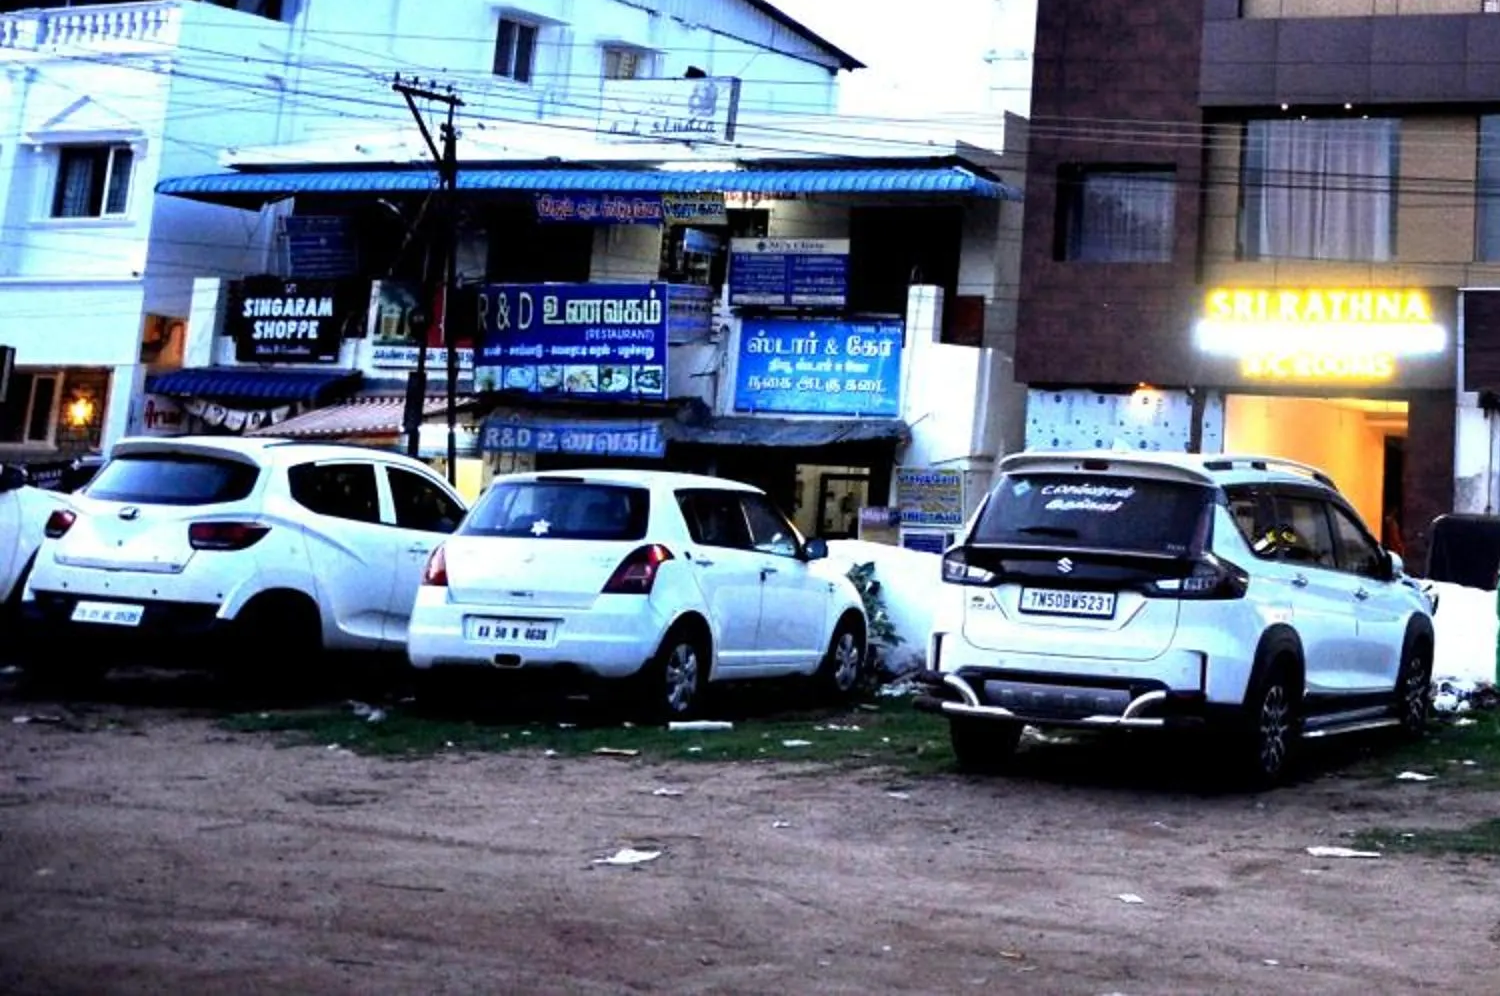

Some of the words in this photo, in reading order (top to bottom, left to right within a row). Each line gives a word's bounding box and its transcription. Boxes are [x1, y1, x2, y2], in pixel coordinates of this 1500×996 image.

[242, 297, 333, 317] SINGARAM
[497, 291, 511, 330] &
[517, 292, 534, 330] D
[543, 288, 662, 325] உணவகம்
[1211, 290, 1268, 319] SRI
[1279, 290, 1431, 322] RATHNA
[252, 319, 320, 339] SHOPPE
[747, 330, 819, 355] ஸ்டார்
